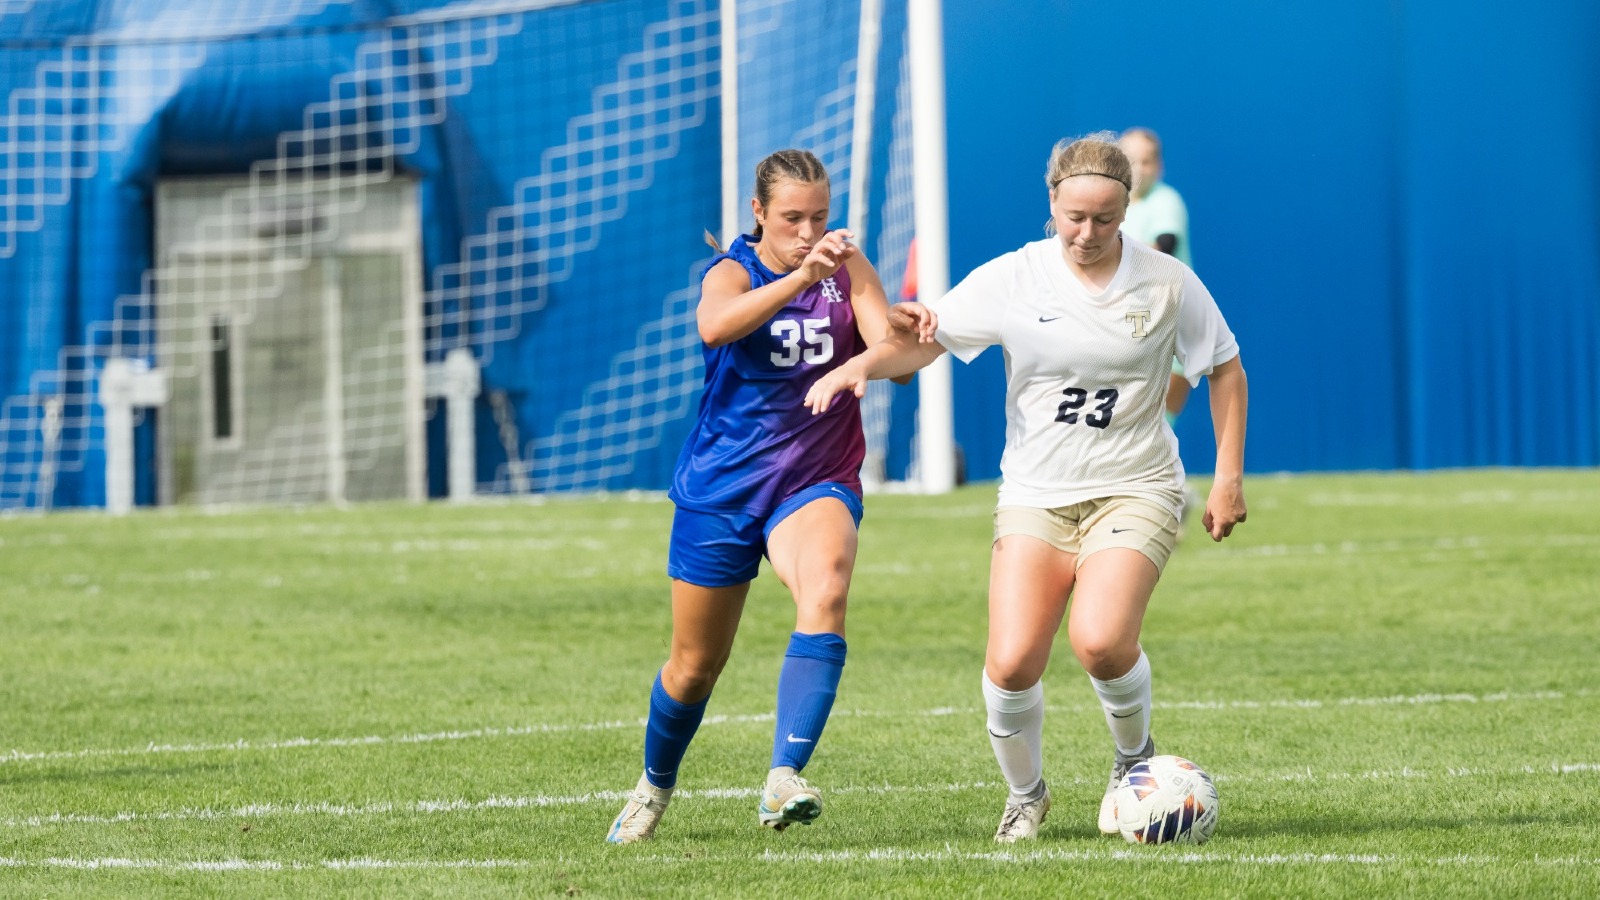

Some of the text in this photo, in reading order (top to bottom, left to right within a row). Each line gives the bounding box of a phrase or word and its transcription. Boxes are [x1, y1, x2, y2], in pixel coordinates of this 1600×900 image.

[770, 316, 834, 367] 35
[1125, 310, 1151, 338] T
[1054, 387, 1119, 429] 23
